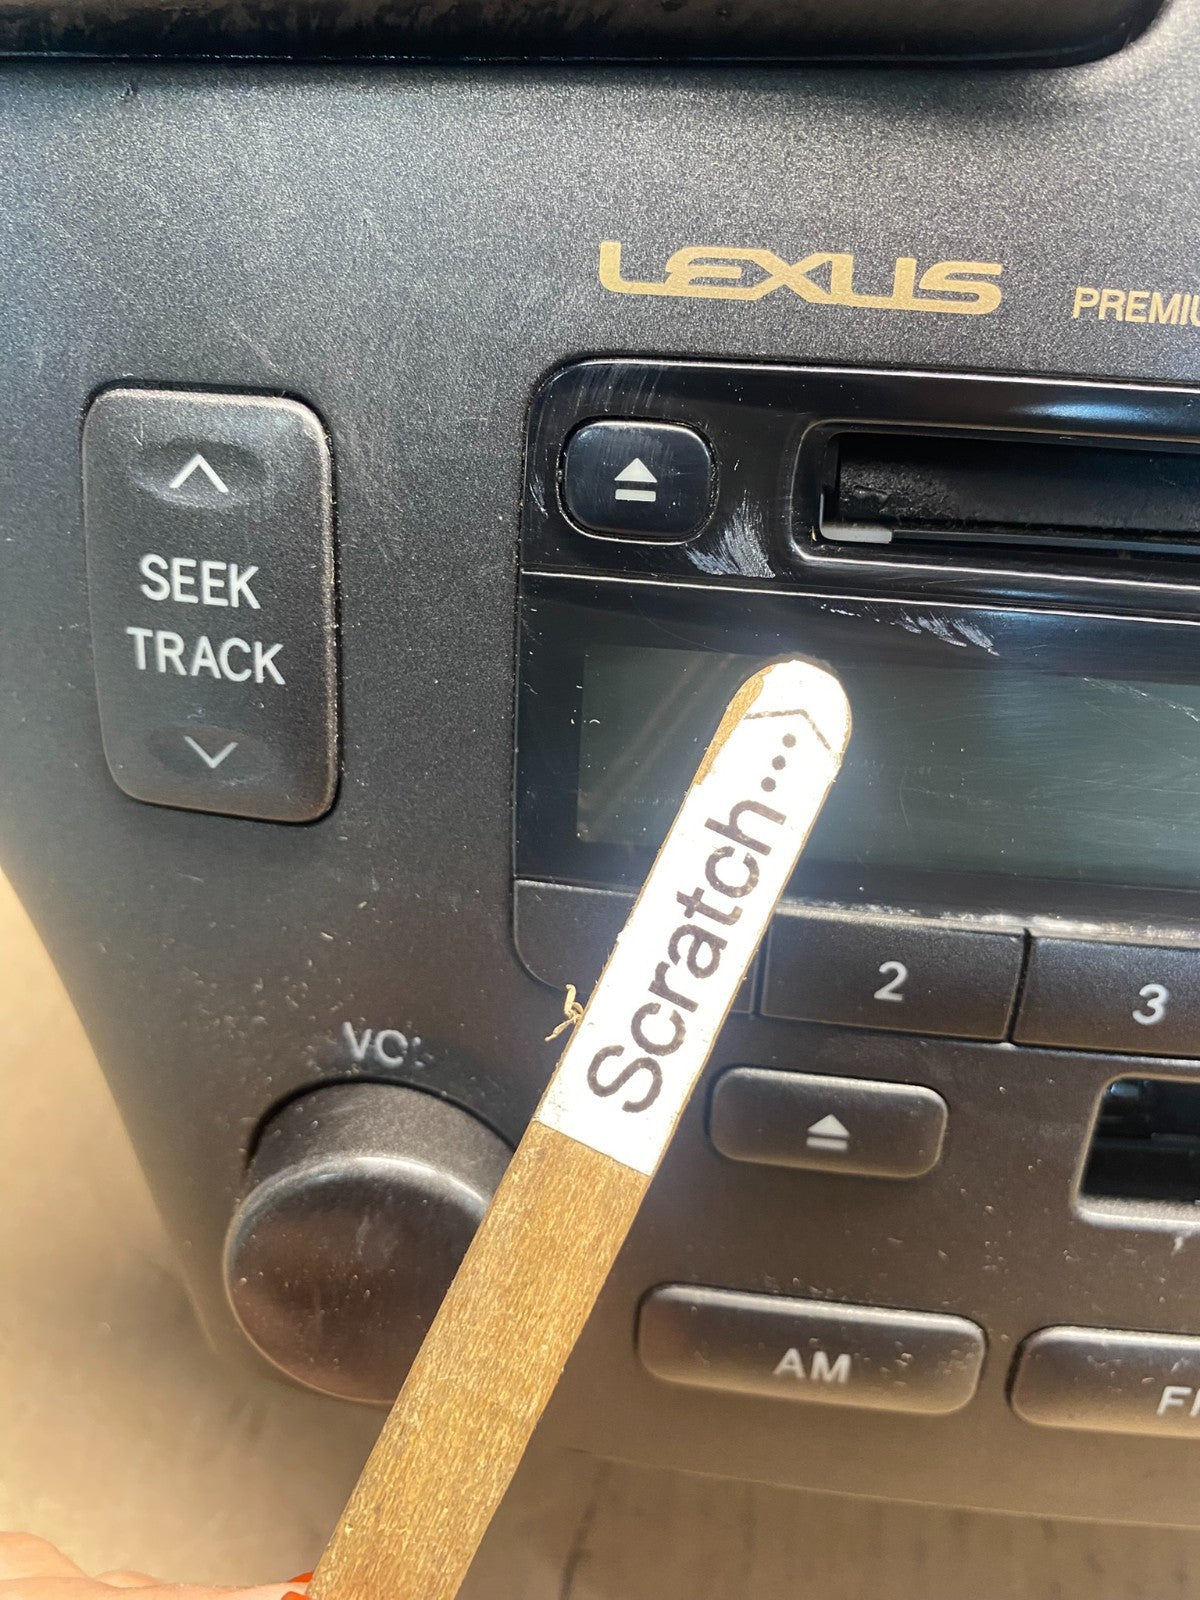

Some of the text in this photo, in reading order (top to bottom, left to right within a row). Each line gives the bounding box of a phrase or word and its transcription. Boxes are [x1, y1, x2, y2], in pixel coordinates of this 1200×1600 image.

[599, 241, 1003, 315] LEXUS
[139, 553, 262, 610] SEEK
[126, 627, 286, 686] TRACK
[873, 961, 909, 1001] 2
[1132, 984, 1170, 1026] 3
[773, 1347, 853, 1385] AM
[1156, 1385, 1200, 1419] F
